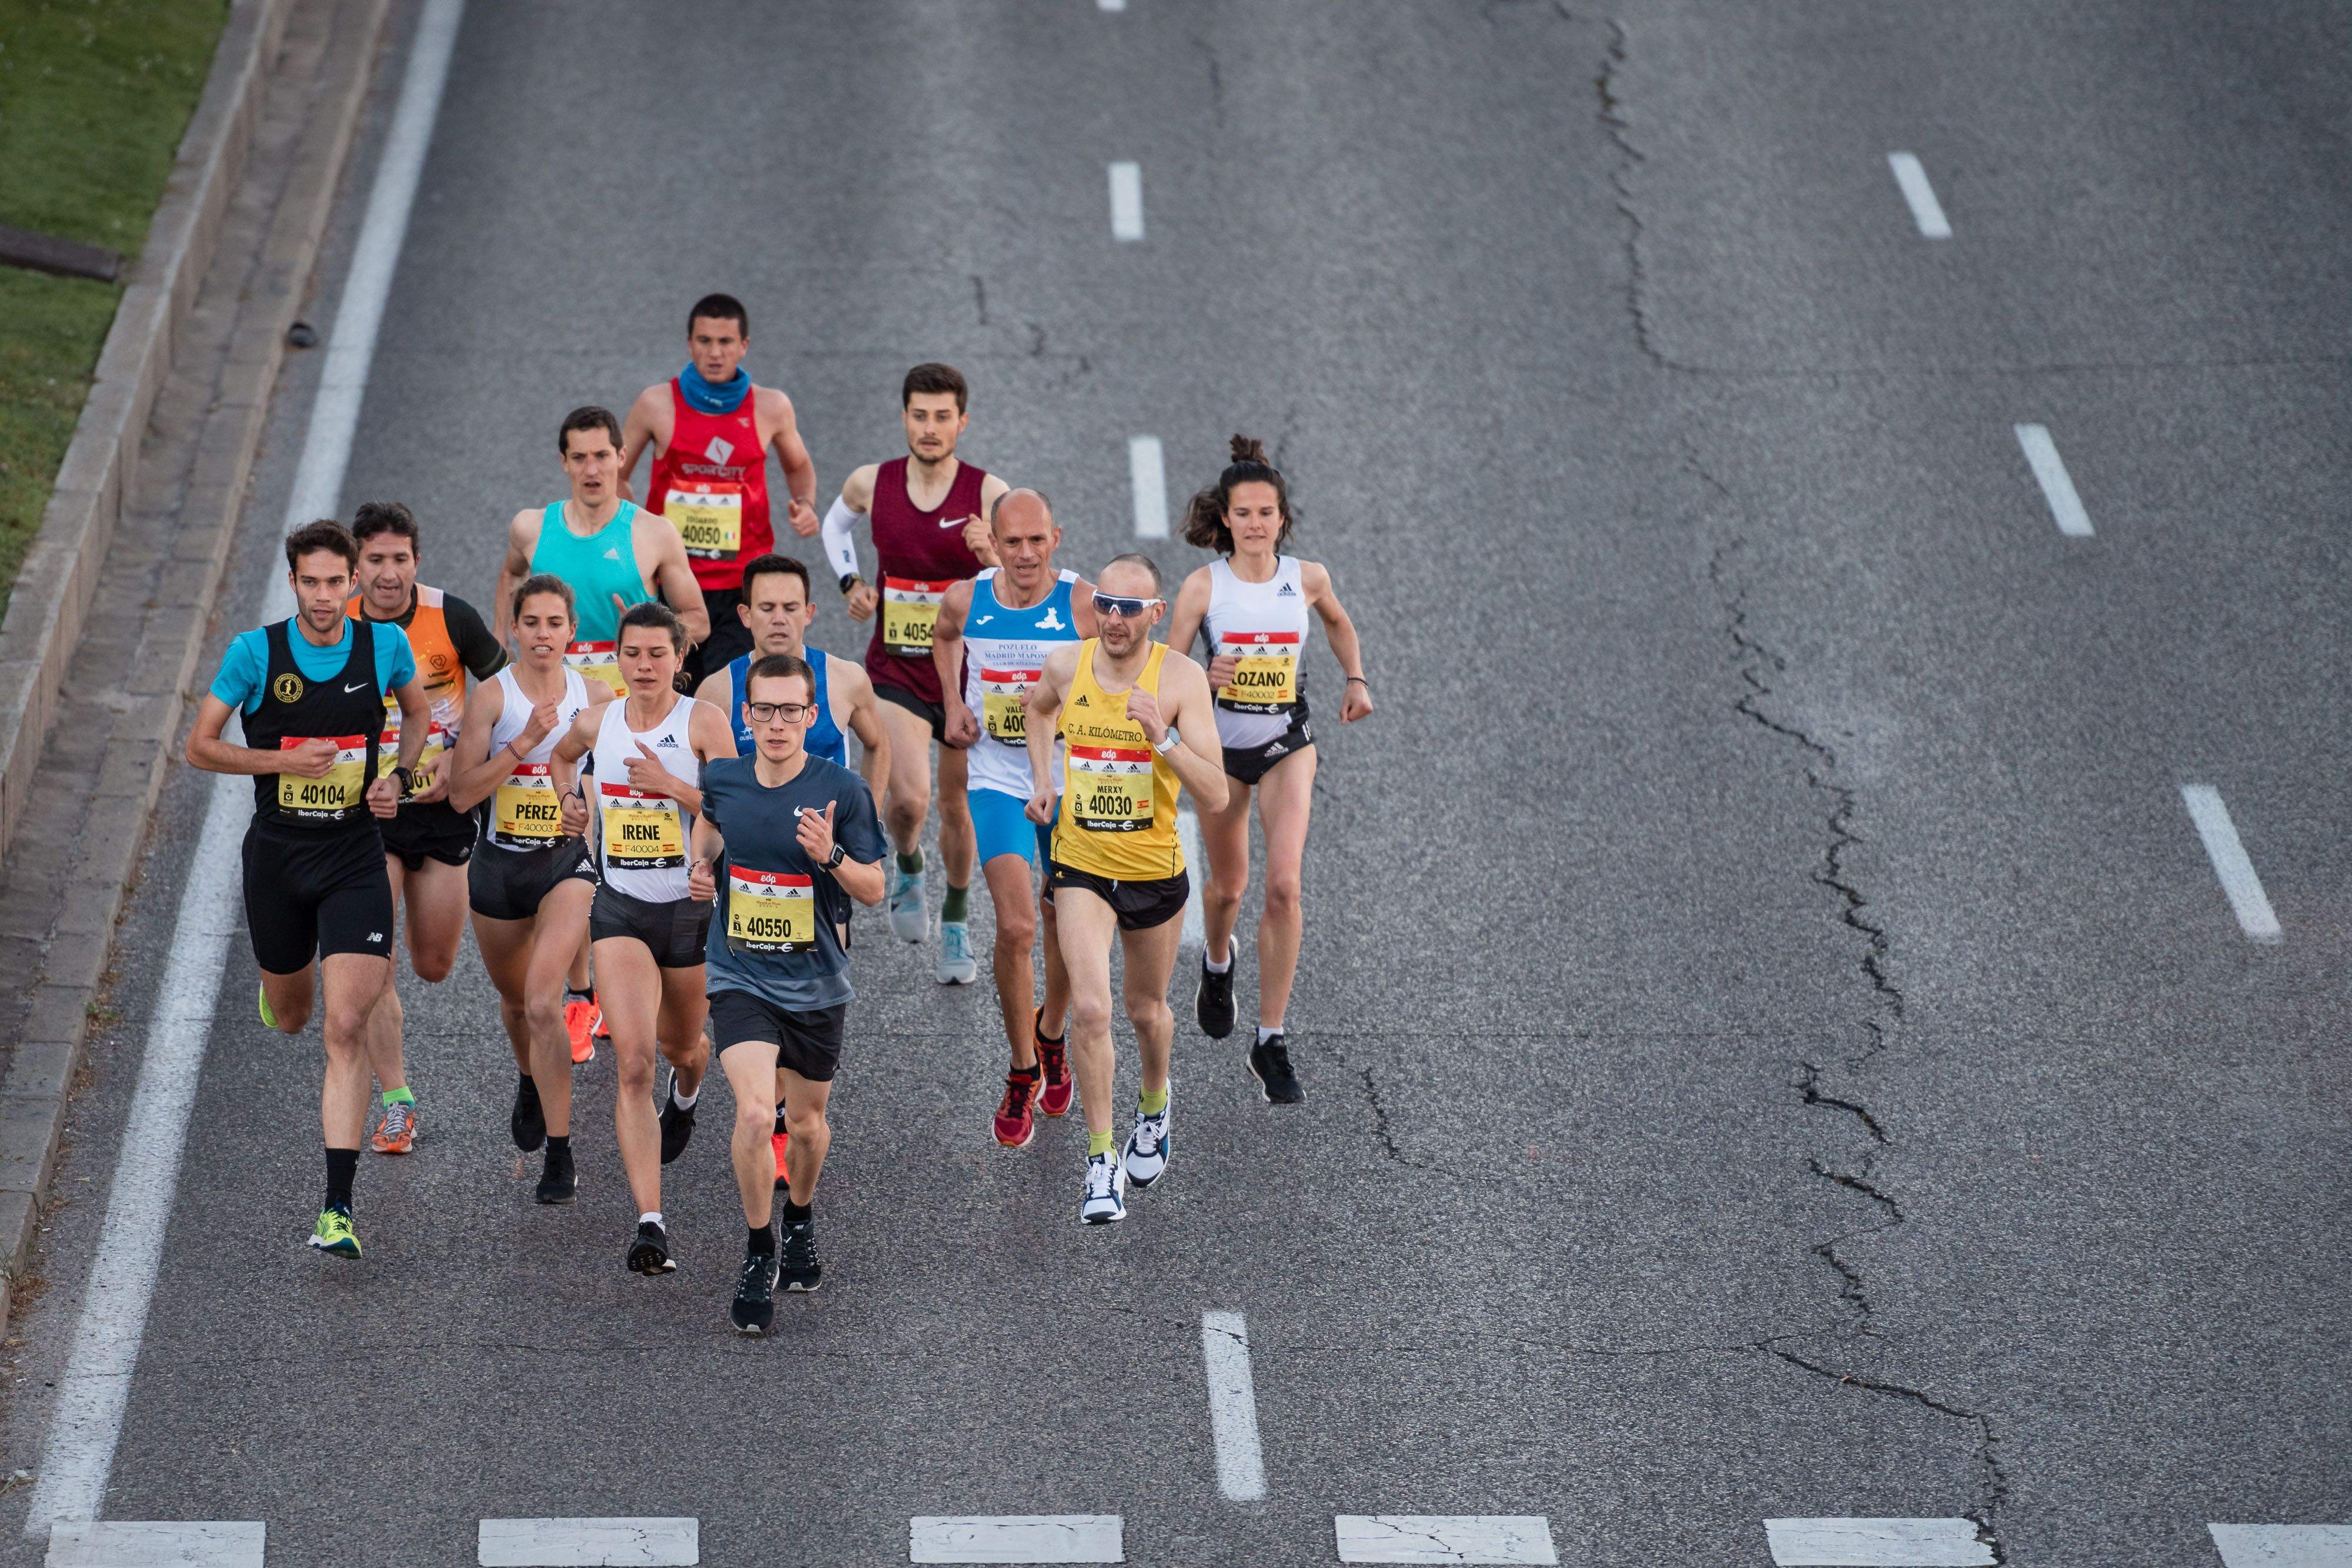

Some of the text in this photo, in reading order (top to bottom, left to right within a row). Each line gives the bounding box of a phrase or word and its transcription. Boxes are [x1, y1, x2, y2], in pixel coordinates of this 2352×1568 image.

[683, 524, 720, 544] 40050
[1254, 633, 1269, 644] edp
[577, 642, 593, 653] edp
[1011, 671, 1027, 681] edp
[1241, 690, 1275, 698] F40002
[1068, 723, 1075, 734] C.
[1077, 725, 1086, 735] A.
[1088, 726, 1142, 742] KILÓMETRO
[1101, 748, 1117, 761] edp
[532, 764, 547, 775] edp
[300, 784, 345, 805] 40104
[1097, 785, 1122, 794] MERXY
[516, 801, 558, 820] PÉREZ
[1089, 795, 1132, 815] 40030
[518, 823, 553, 833] F40003
[622, 824, 660, 840] IRENE
[625, 845, 659, 853] F40004
[760, 874, 776, 885] edp
[747, 917, 791, 938] 40550
